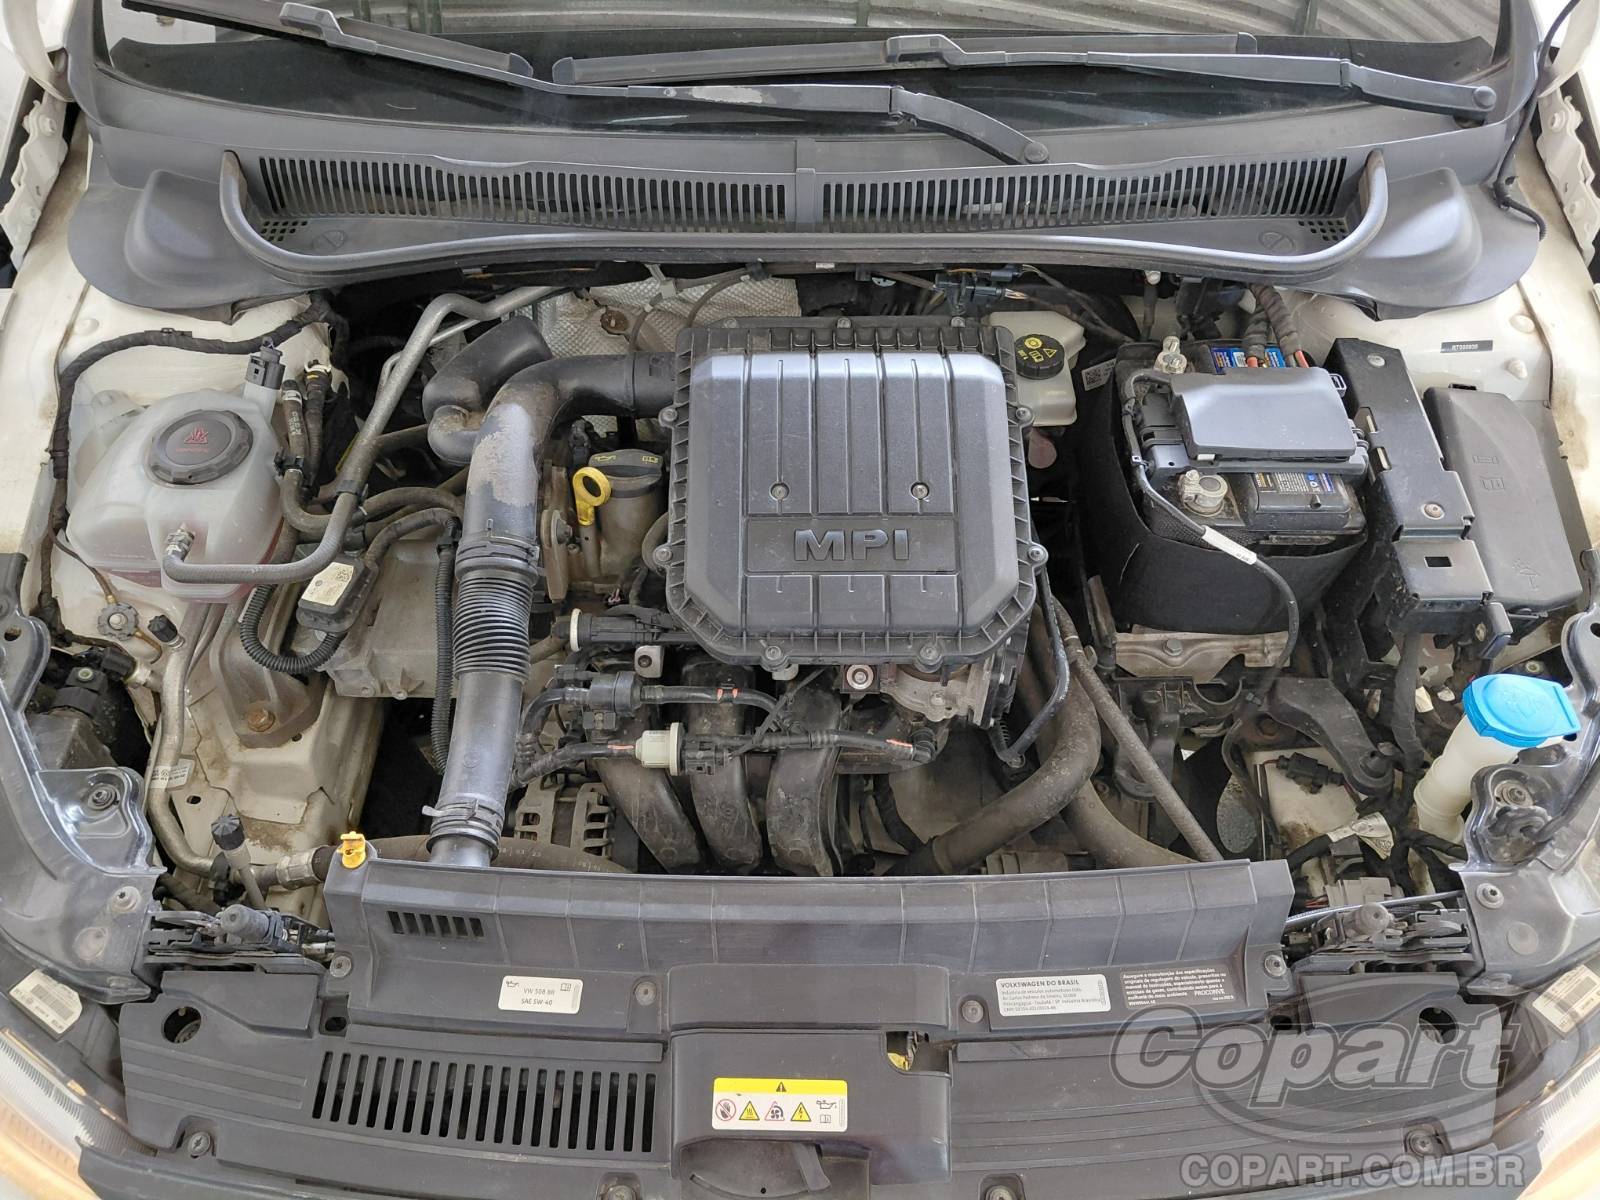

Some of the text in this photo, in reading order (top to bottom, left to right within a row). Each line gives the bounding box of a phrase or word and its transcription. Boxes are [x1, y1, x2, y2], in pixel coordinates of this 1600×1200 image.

[794, 529, 909, 561] MPI
[1000, 980, 1045, 988] VOLKSWAGEN
[1057, 978, 1080, 986] BRASIL
